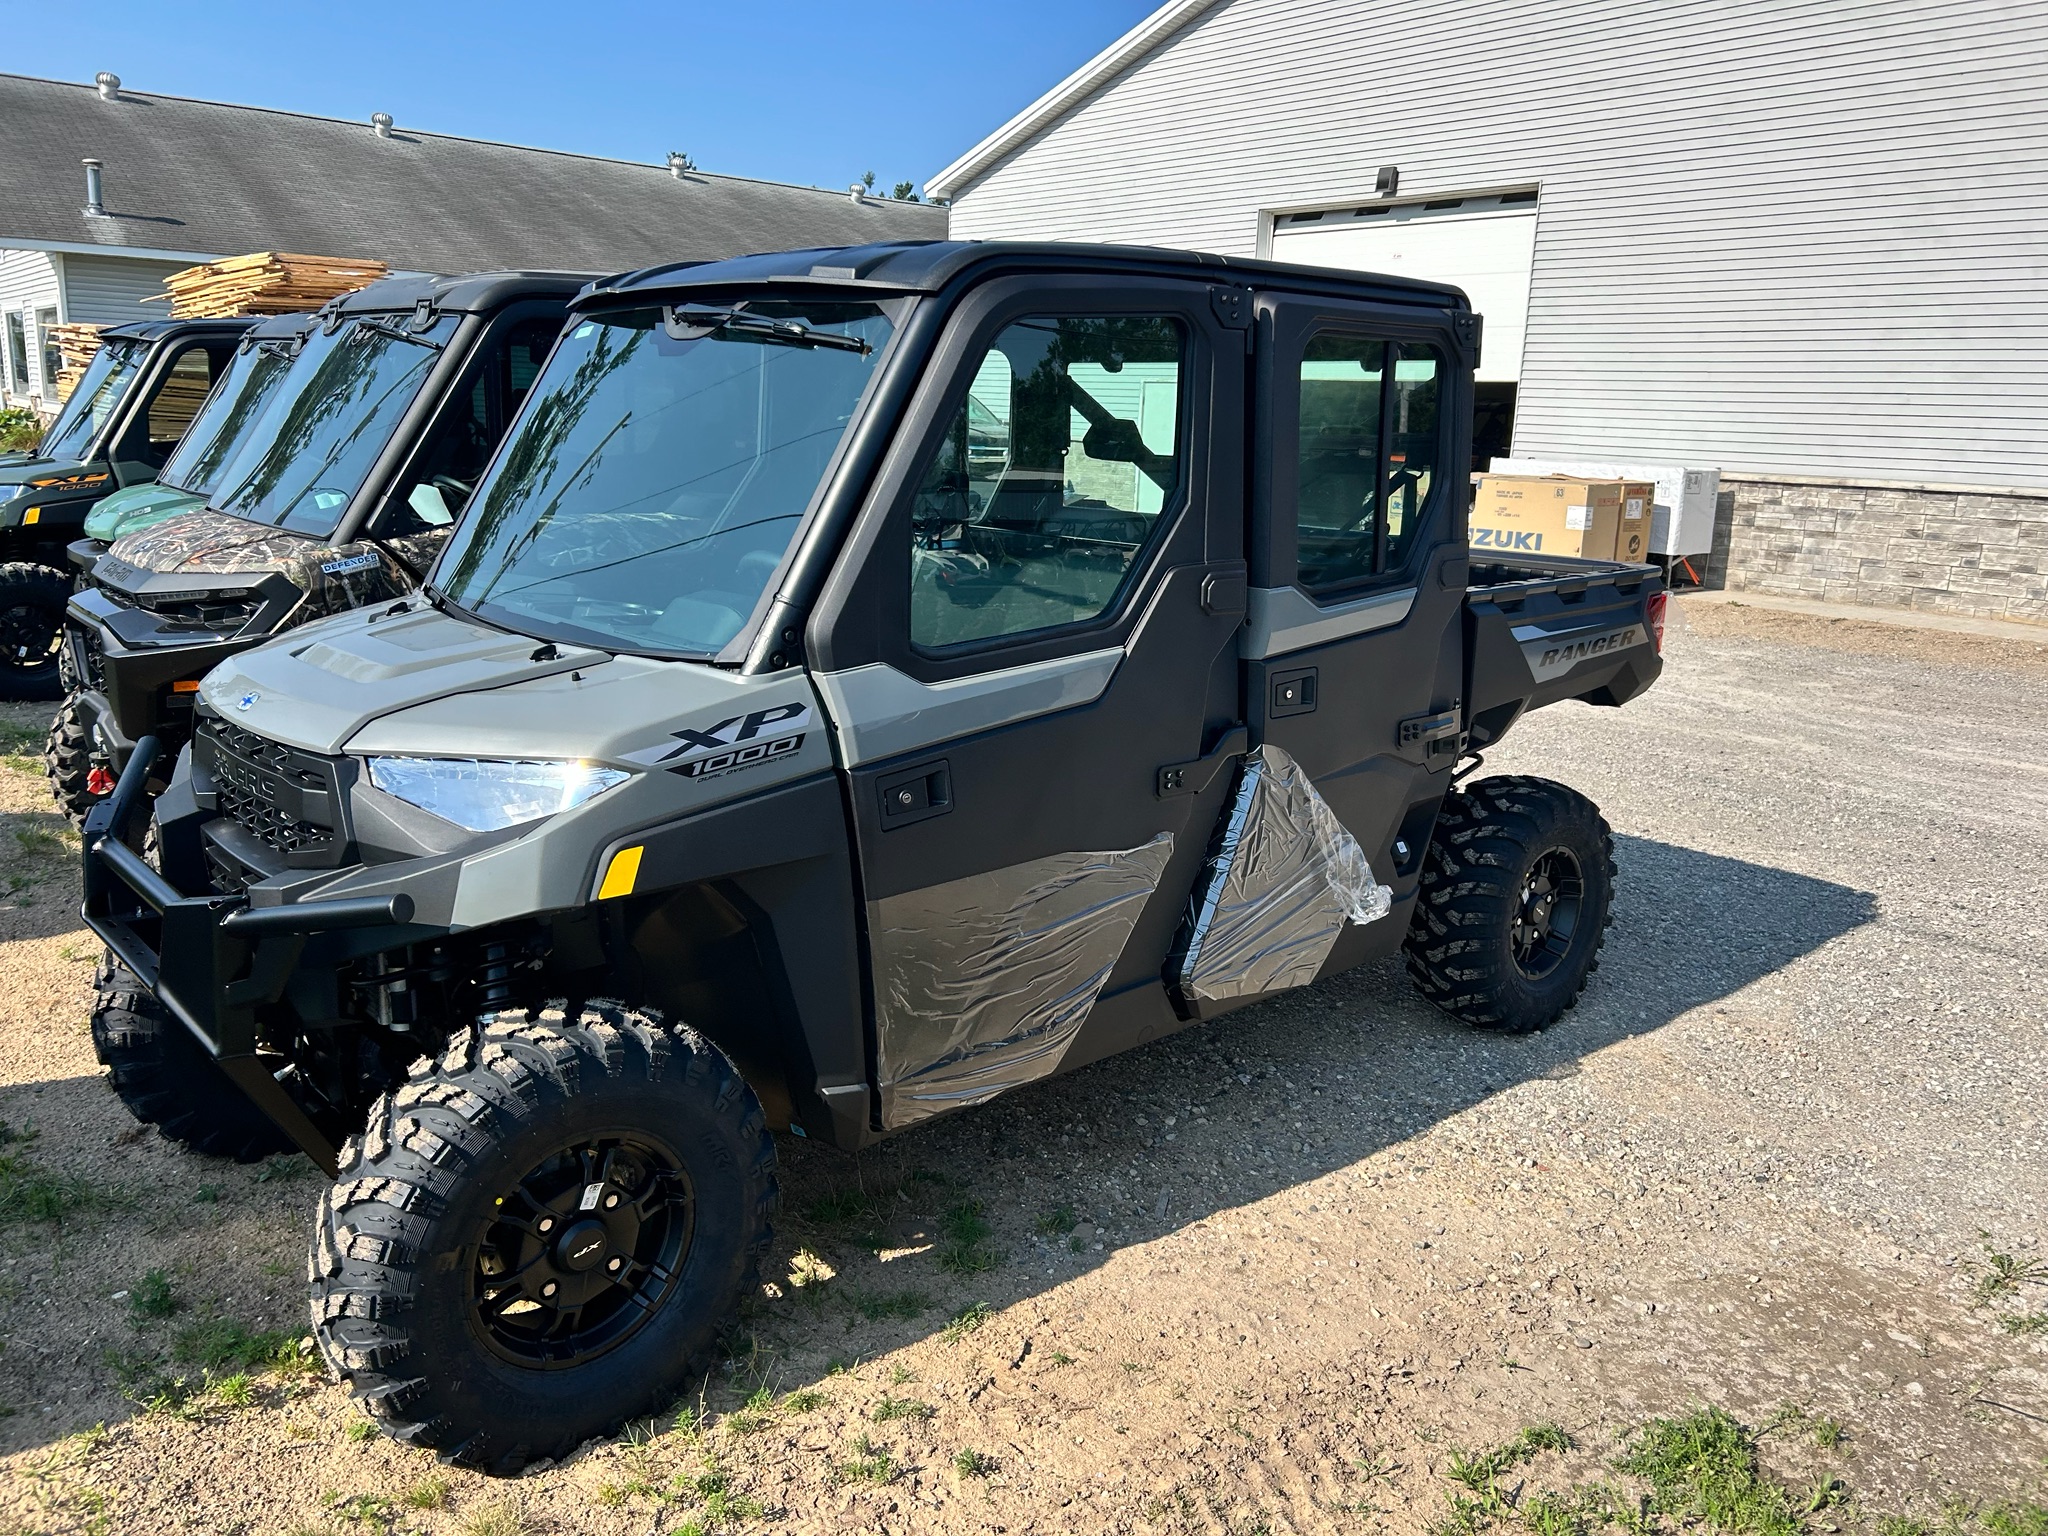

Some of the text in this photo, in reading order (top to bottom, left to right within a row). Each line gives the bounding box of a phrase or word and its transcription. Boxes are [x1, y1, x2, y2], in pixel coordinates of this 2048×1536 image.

[46, 473, 107, 486] XP
[59, 482, 102, 491] 1000
[323, 554, 378, 572] DEFENDER
[1538, 629, 1636, 668] RANGER
[653, 701, 808, 764] XP
[691, 735, 799, 777] 1000
[696, 752, 800, 783] DUAL OVERHEAD CAM
